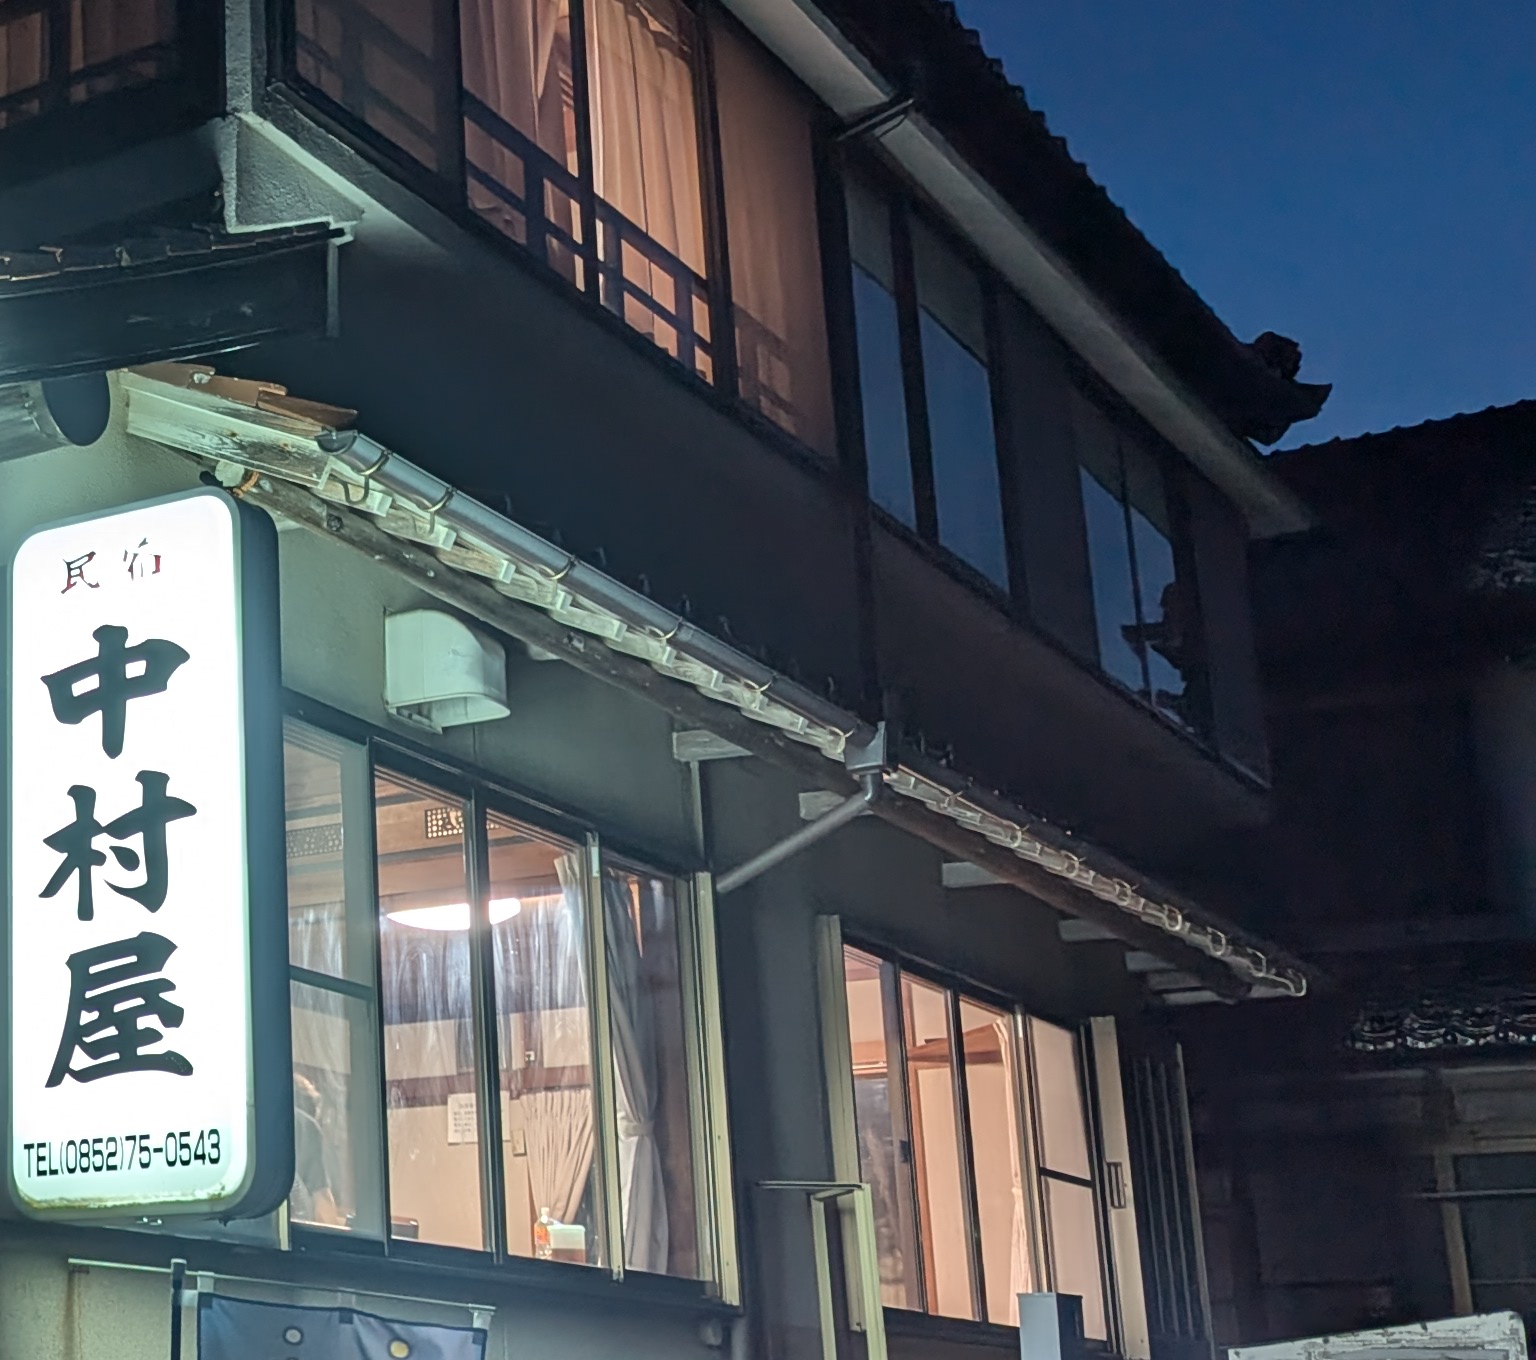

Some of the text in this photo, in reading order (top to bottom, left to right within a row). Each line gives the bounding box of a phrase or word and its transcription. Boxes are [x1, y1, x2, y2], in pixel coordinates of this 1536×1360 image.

[39, 624, 198, 1088] 中村屋
[23, 1128, 222, 1178] TEL(0852)75-0543
